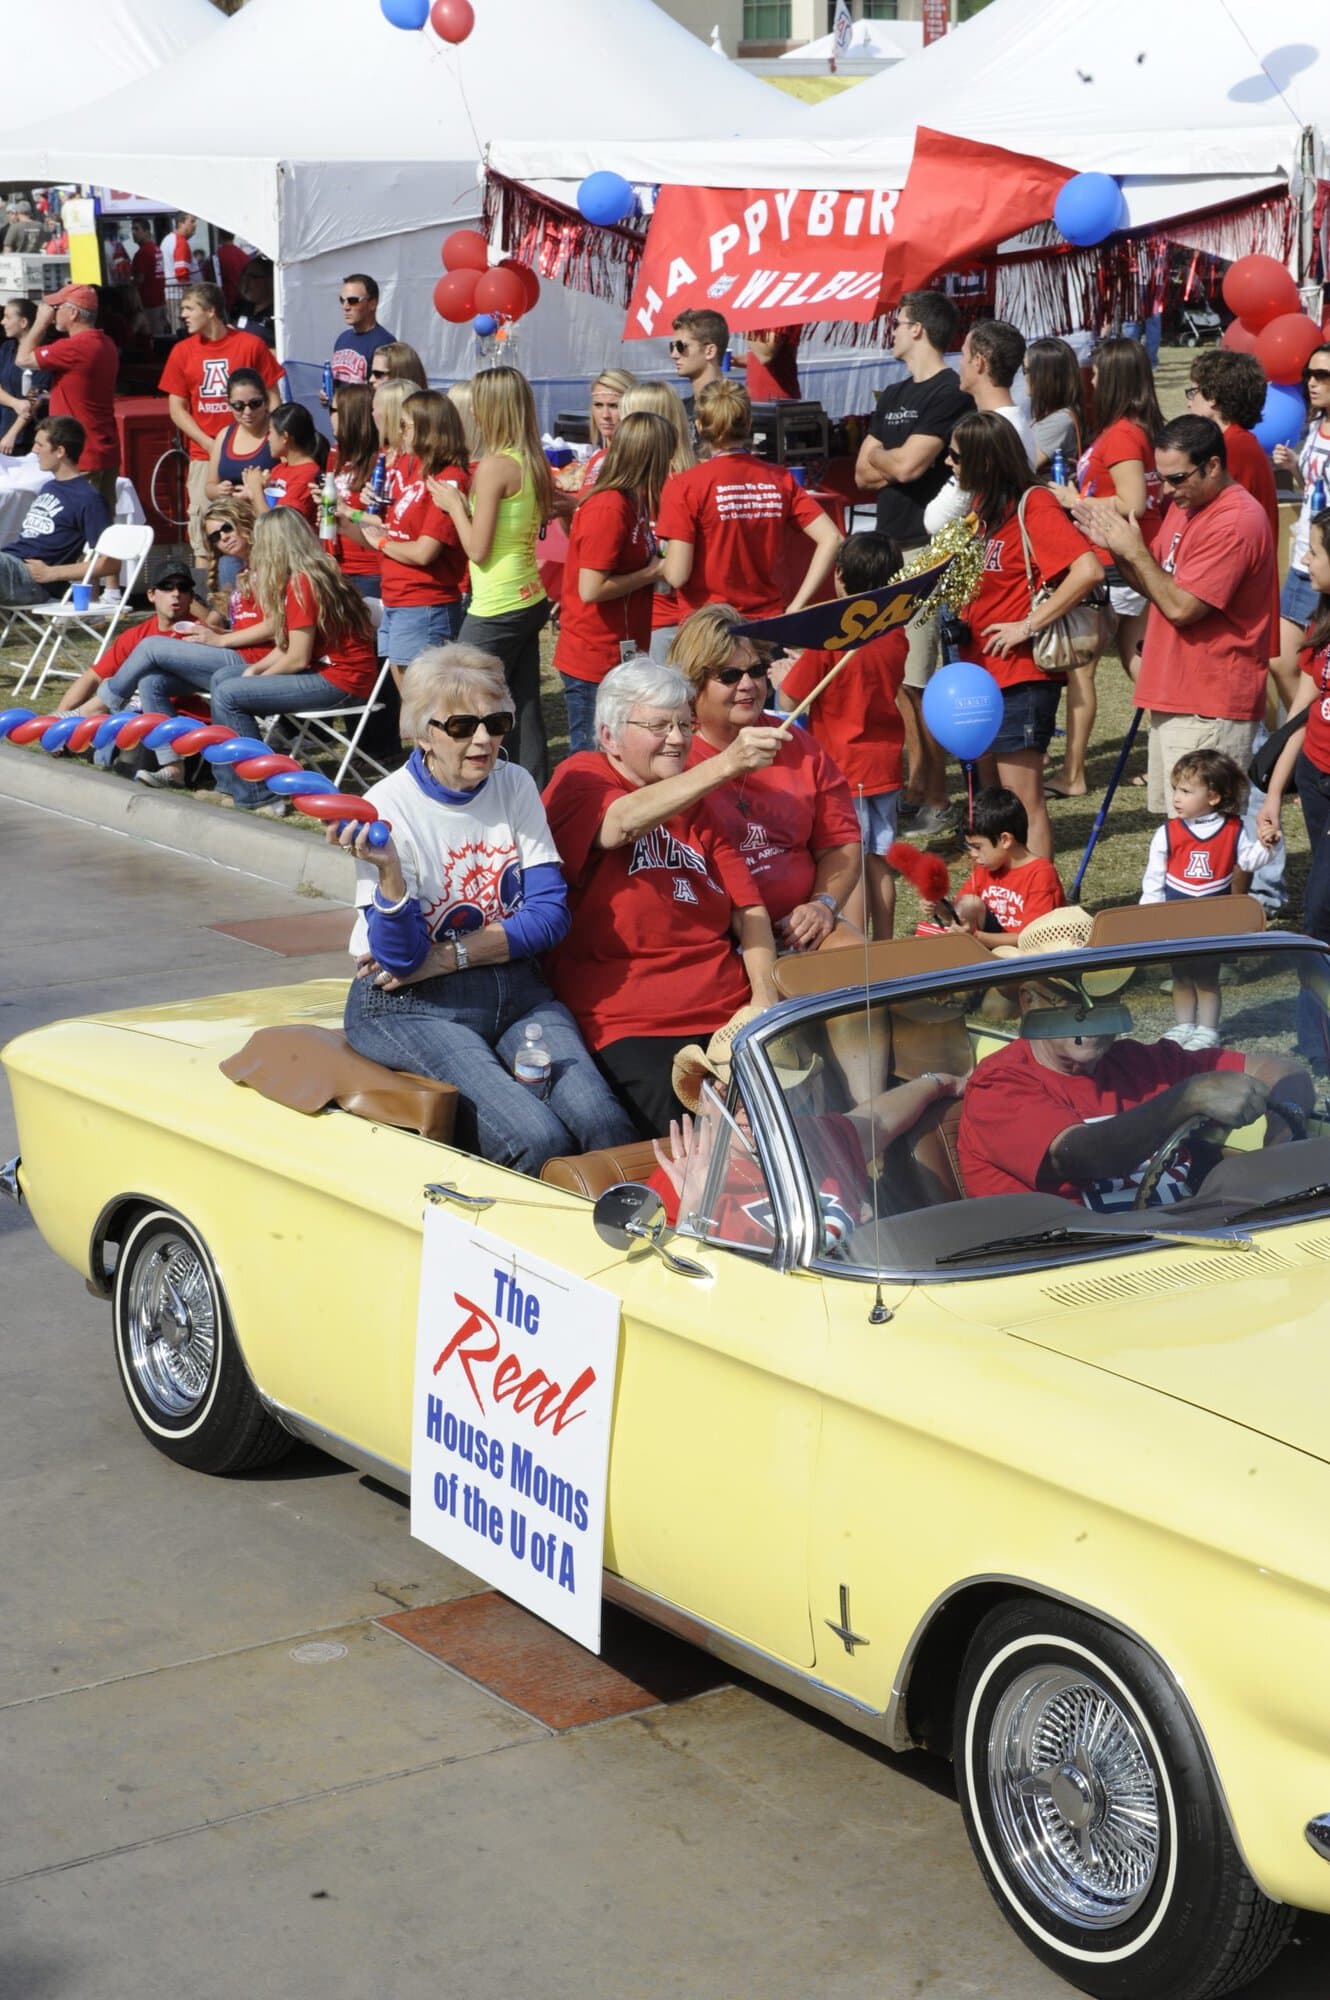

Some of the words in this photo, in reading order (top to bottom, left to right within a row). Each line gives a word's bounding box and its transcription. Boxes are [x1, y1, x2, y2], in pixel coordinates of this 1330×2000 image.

[636, 190, 799, 336] HAPPY
[199, 358, 229, 398] A
[198, 400, 233, 413] ARIZO
[740, 822, 768, 851] A
[1183, 850, 1214, 879] A
[463, 869, 497, 901] BEAR
[671, 876, 699, 905] A
[493, 1267, 541, 1336] The
[432, 1290, 597, 1437] Real
[426, 1392, 505, 1480] House
[509, 1441, 590, 1532] Moms
[433, 1471, 459, 1518] of
[463, 1487, 504, 1546] the
[509, 1510, 526, 1560] U
[530, 1531, 558, 1580] of
[558, 1540, 577, 1595] A
